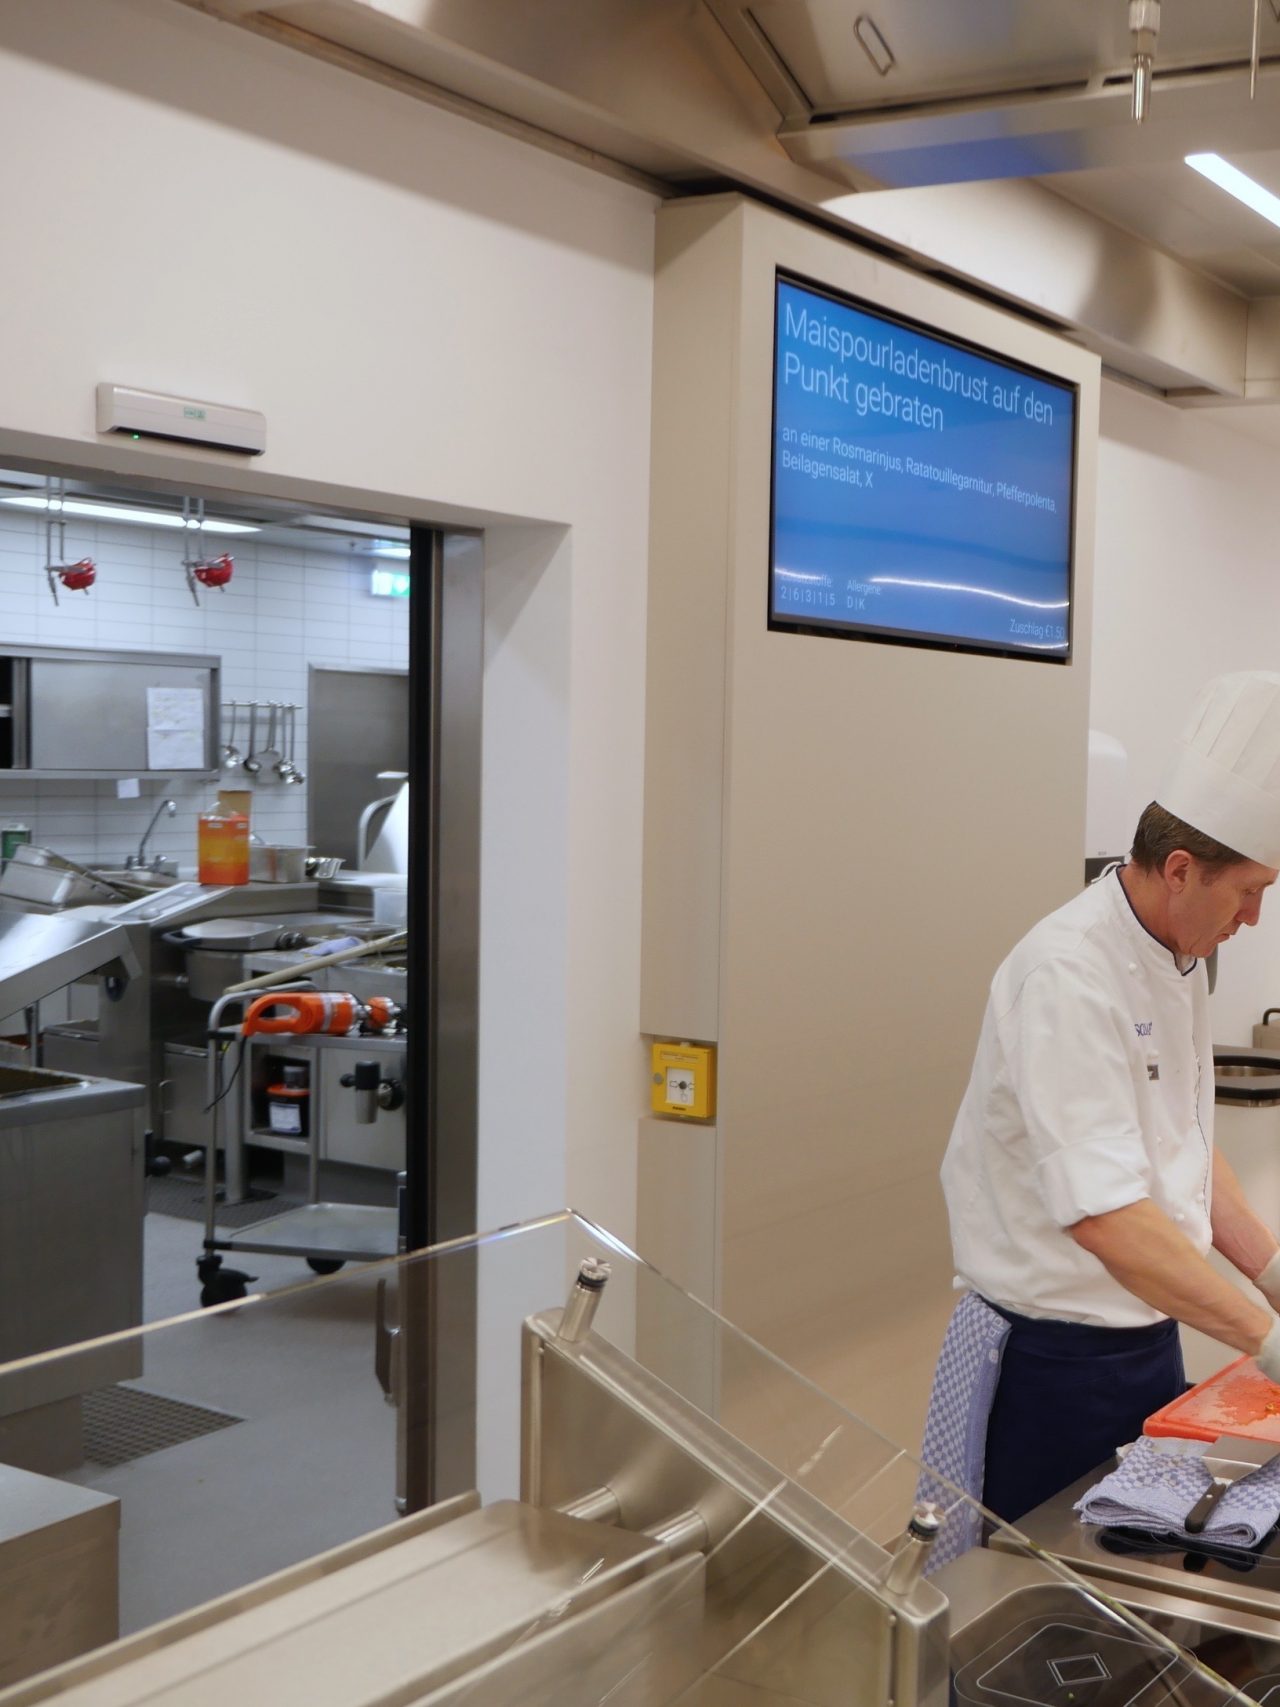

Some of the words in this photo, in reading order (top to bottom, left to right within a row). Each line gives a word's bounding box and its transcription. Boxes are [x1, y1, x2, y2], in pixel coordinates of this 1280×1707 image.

[784, 352, 850, 404] Punkt
[855, 382, 944, 432] gebraten
[785, 302, 989, 404] Maispourladenbrust
[992, 384, 1020, 414] auf
[1024, 390, 1054, 426] den
[782, 427, 798, 443] an
[800, 430, 830, 452] einer
